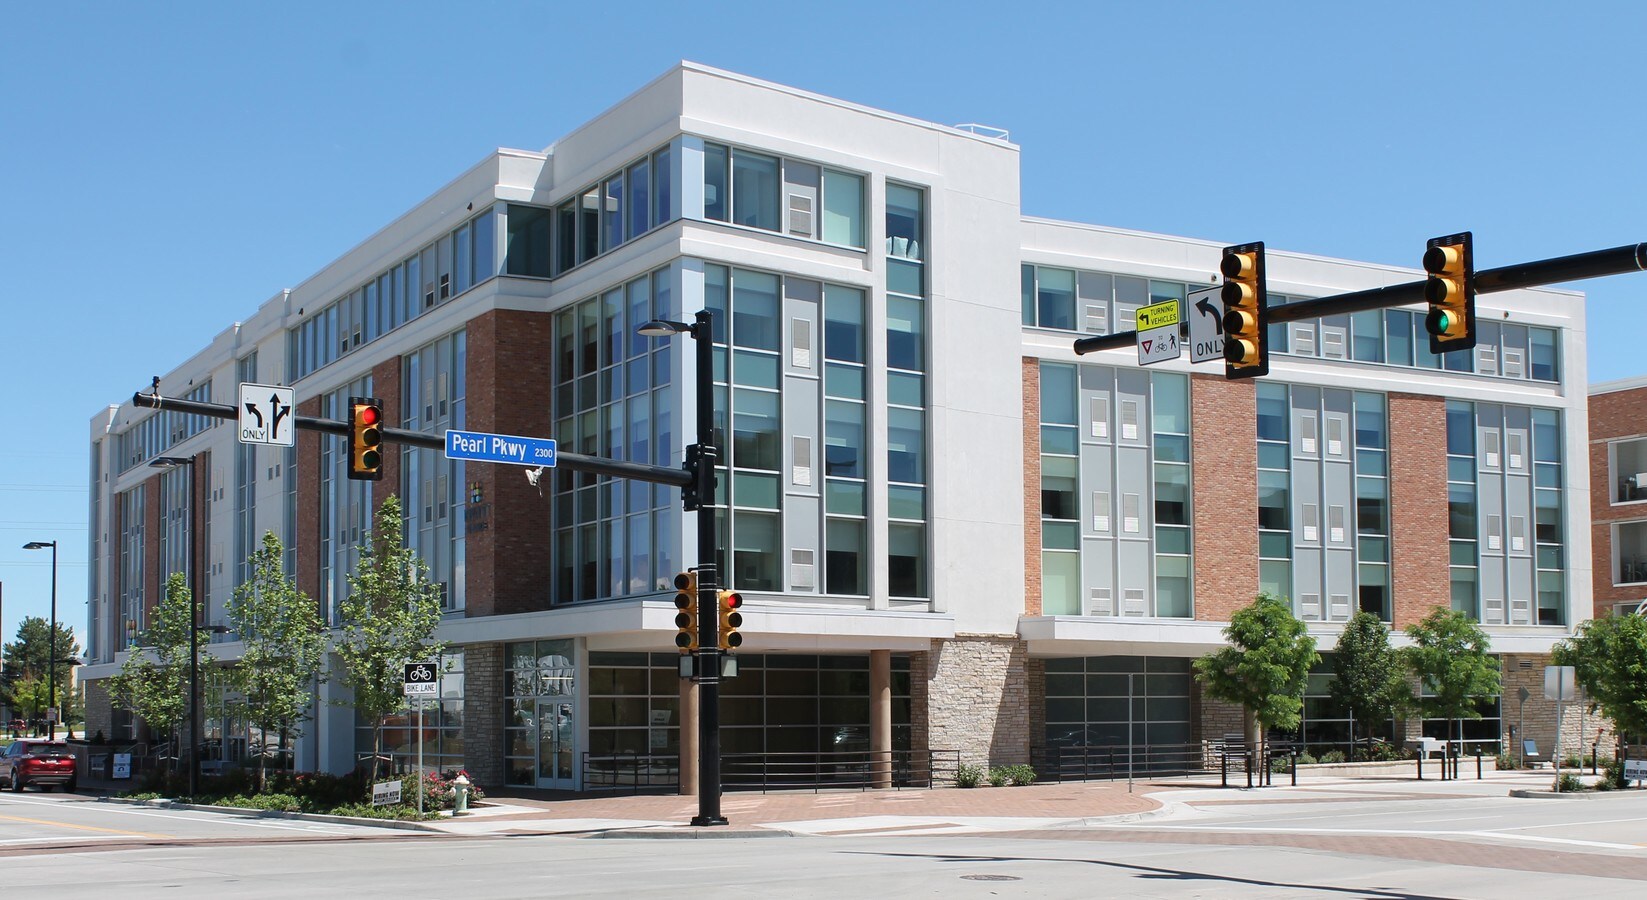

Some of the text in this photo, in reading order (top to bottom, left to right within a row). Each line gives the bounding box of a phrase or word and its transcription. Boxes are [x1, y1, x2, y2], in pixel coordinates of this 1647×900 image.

[1150, 304, 1174, 316] TURNING
[1151, 313, 1177, 325] VEHICLES
[243, 429, 265, 440] ONLY
[453, 434, 553, 461] Pearl Pkwy 2300
[407, 684, 435, 692] BIKE LANE
